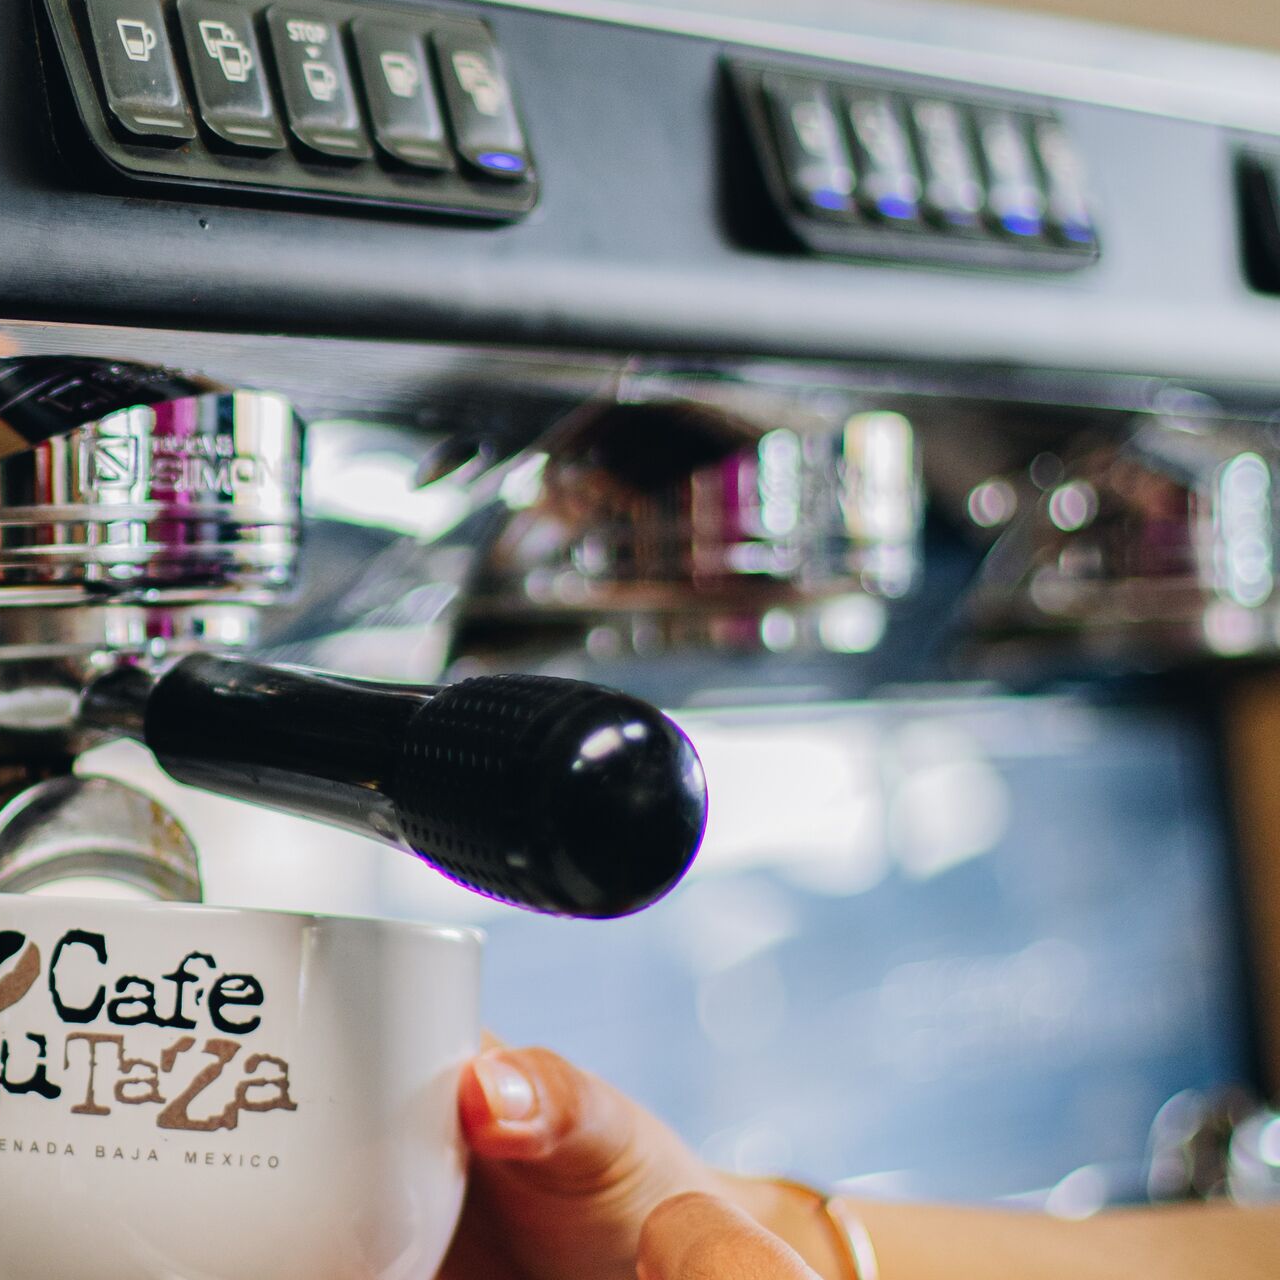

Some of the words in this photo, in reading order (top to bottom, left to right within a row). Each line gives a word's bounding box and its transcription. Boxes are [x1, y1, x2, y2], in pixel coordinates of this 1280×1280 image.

[286, 21, 327, 43] STOP
[49, 928, 264, 1034] Cafe
[95, 1144, 159, 1162] BAJA
[184, 1151, 280, 1169] MEXICO
